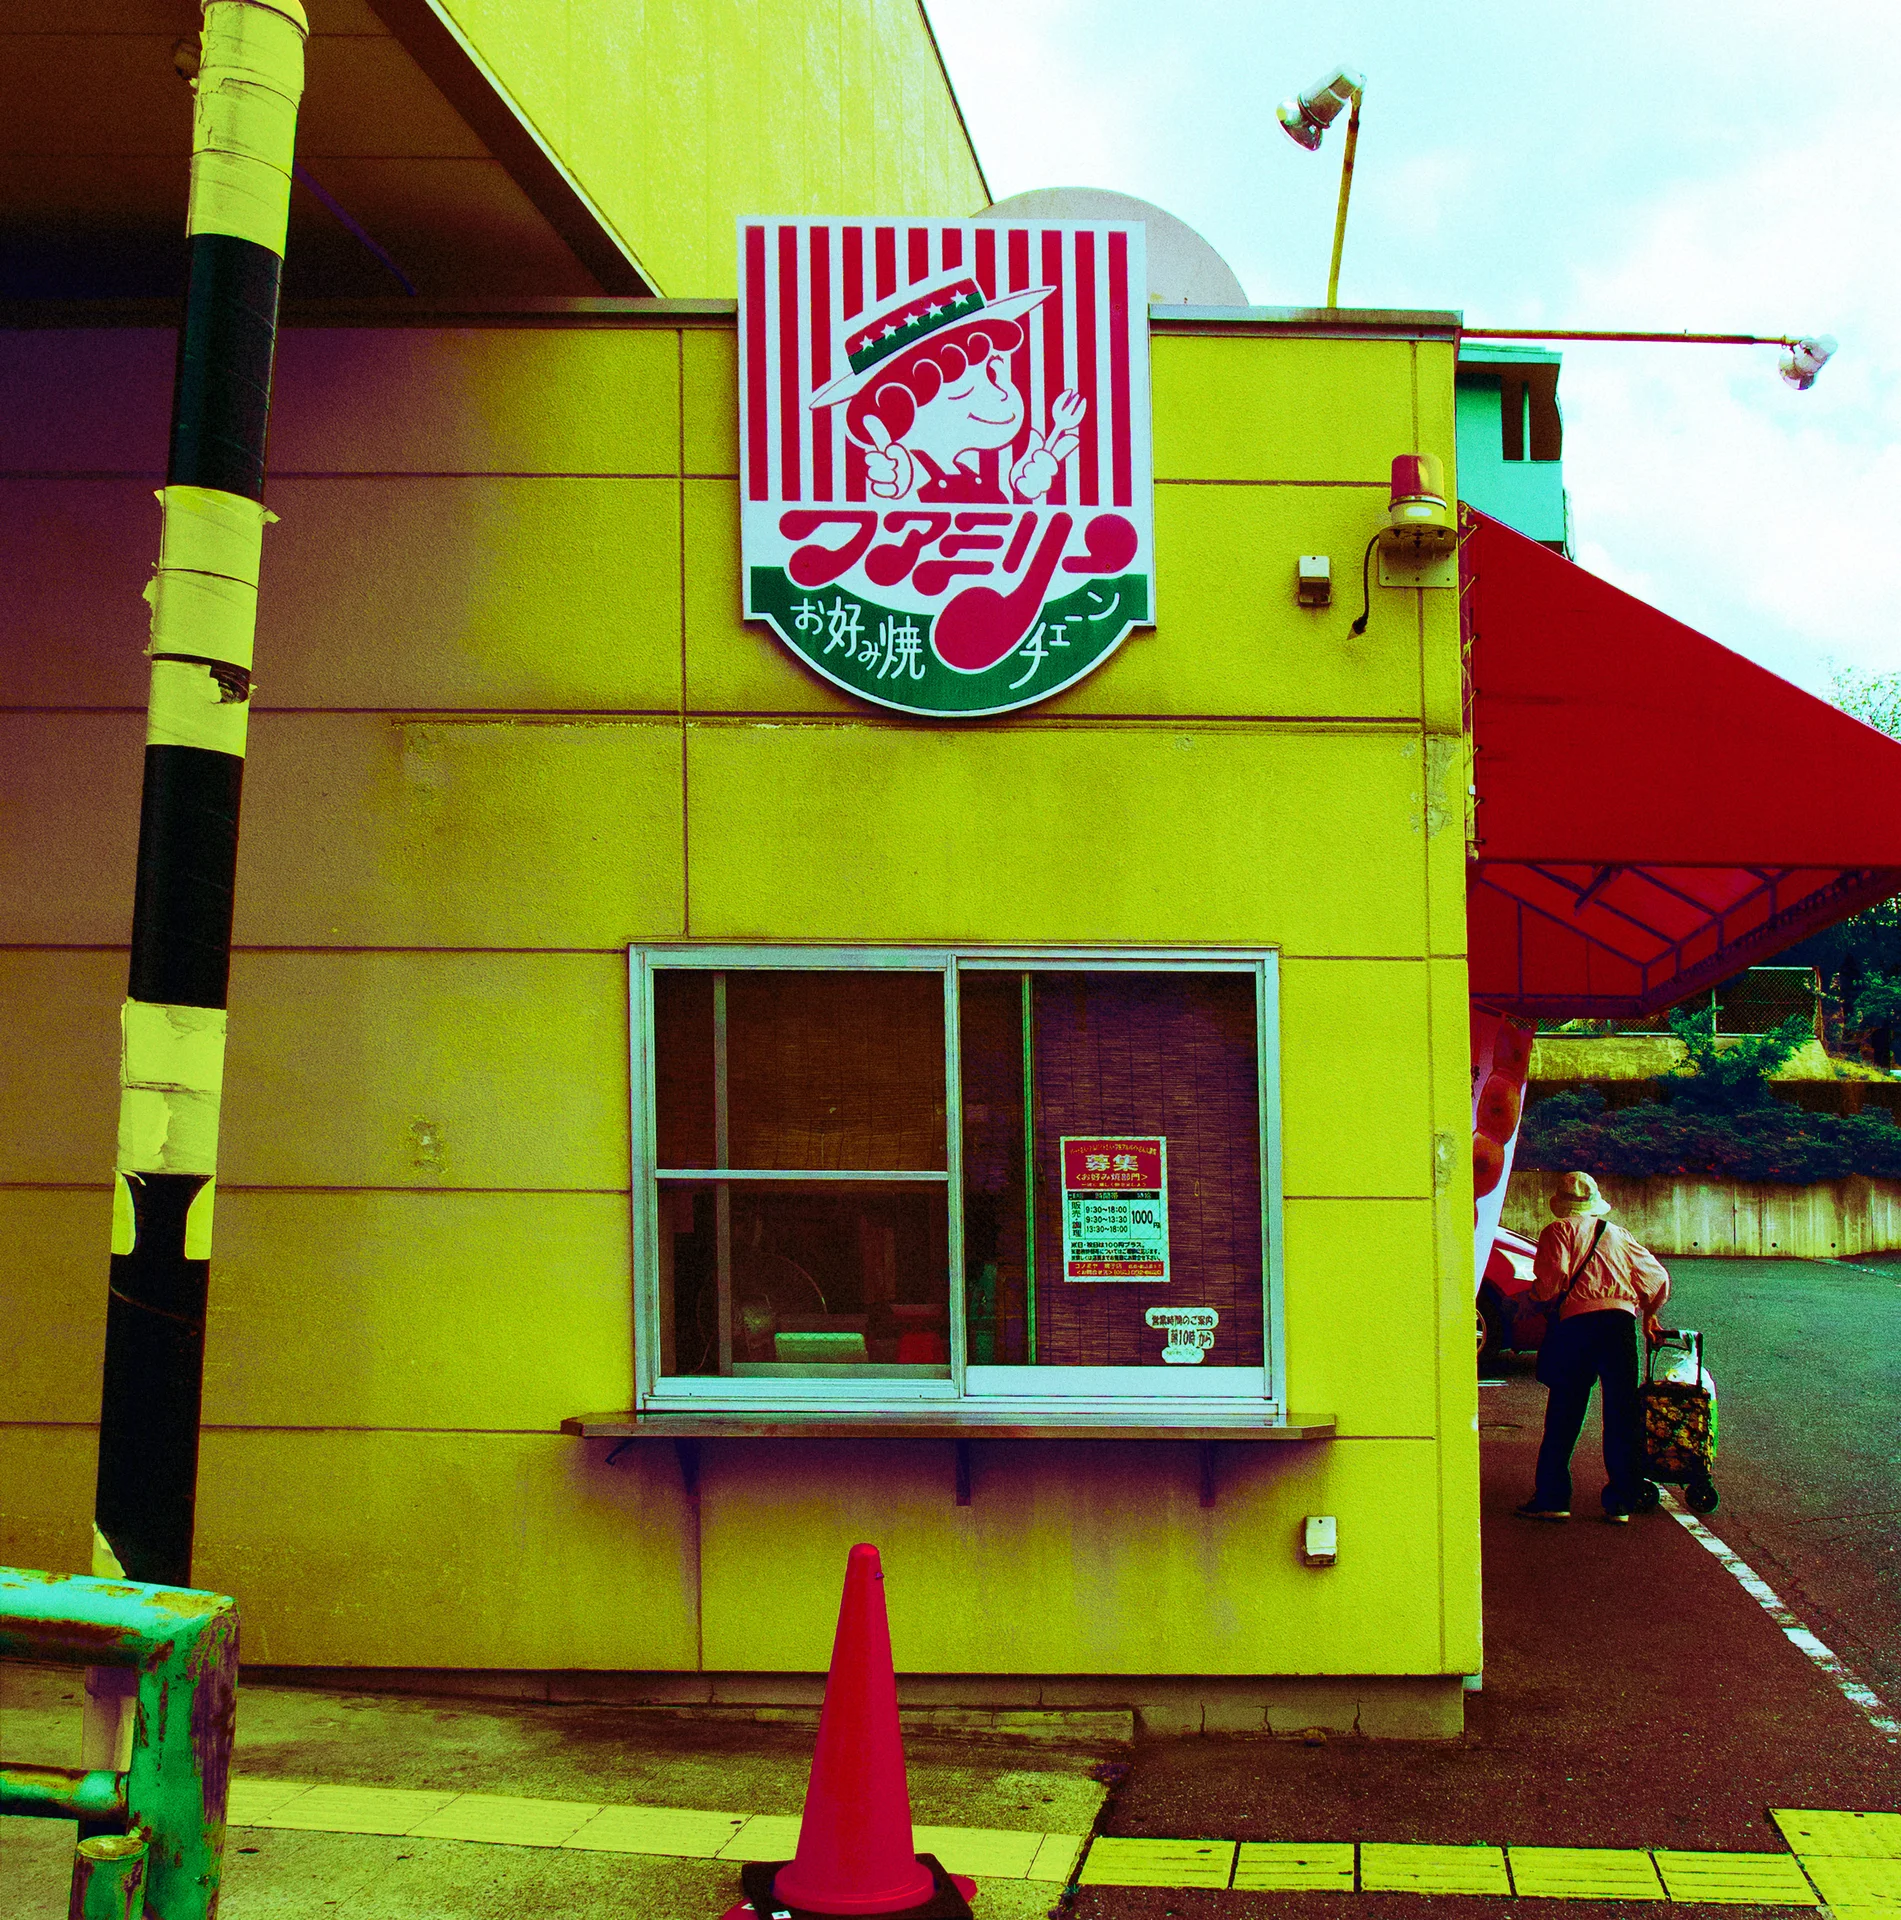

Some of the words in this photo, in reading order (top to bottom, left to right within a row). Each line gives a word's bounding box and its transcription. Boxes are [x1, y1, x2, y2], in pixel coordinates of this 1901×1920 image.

[790, 596, 926, 680] お好み焼
[1009, 591, 1121, 690] チェーン
[1085, 1154, 1139, 1172] 募集
